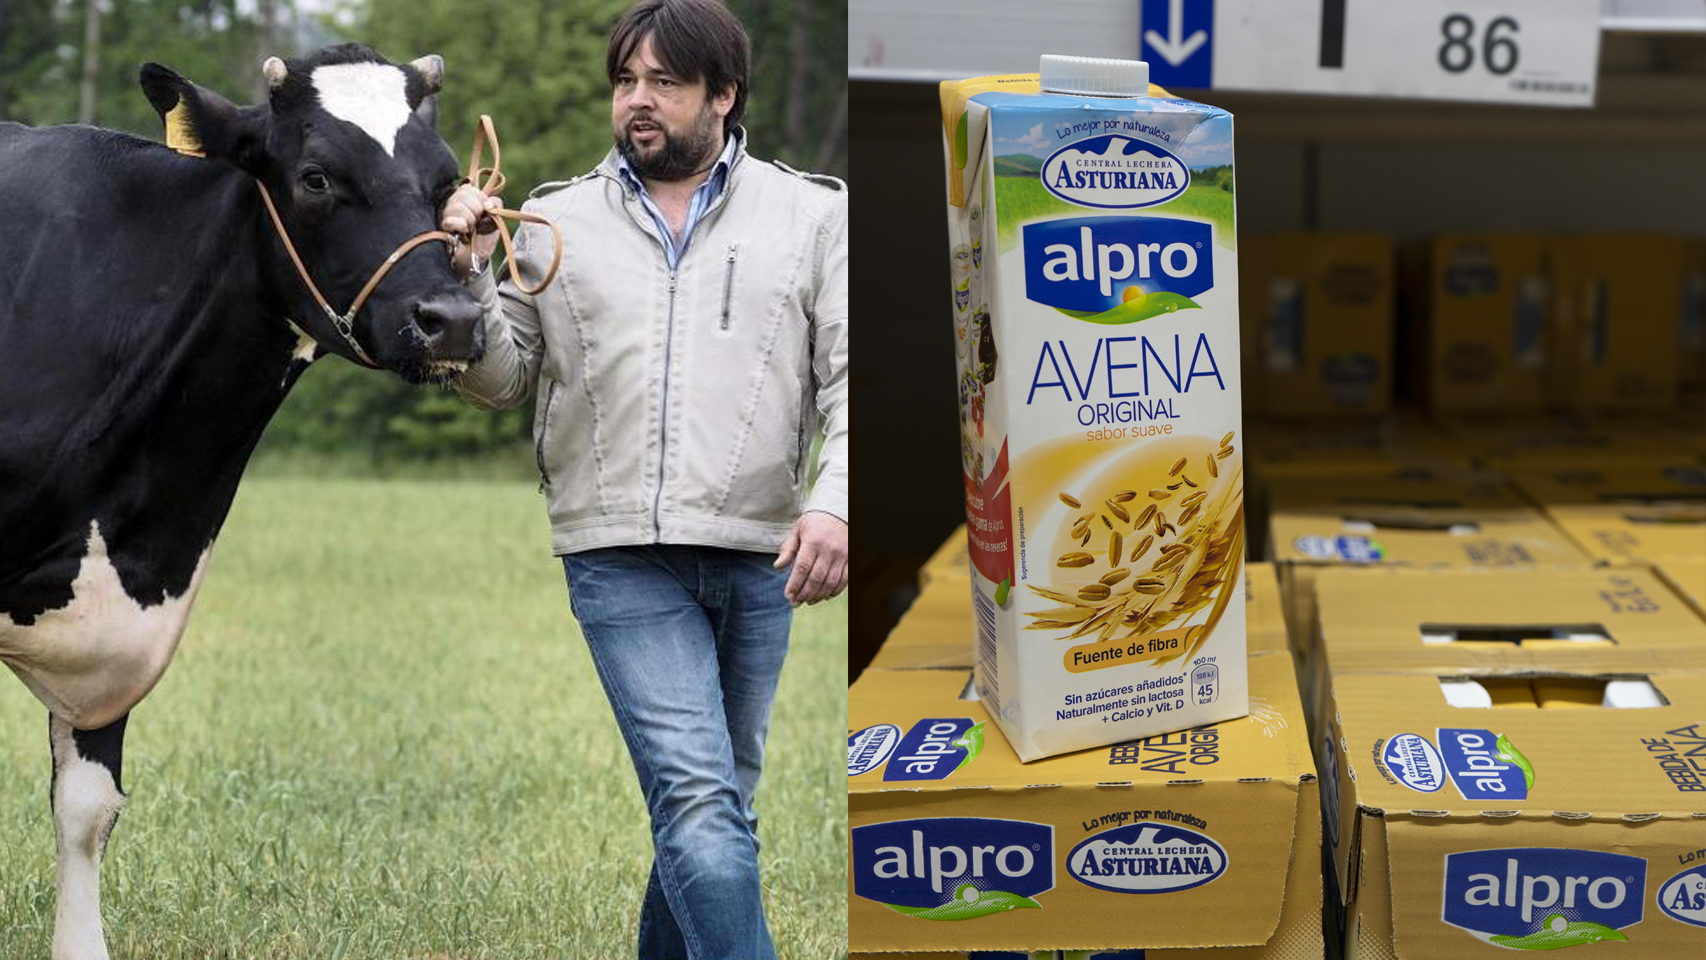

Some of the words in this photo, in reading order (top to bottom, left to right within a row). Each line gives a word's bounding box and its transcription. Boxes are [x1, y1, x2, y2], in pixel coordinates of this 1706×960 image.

[1437, 12, 1521, 76] 86
[1057, 128, 1071, 139] Lo
[1072, 120, 1101, 136] mejor
[1104, 120, 1121, 134] por
[1123, 120, 1171, 142] naturaleza
[1054, 160, 1178, 190] ASTURIANA
[1076, 159, 1122, 167] CENTRAL
[1126, 160, 1172, 168] LECHERA
[1042, 226, 1198, 296] alpro
[1026, 333, 1225, 404] AVENA
[1077, 398, 1180, 426] ORIGINAL
[1087, 426, 1127, 442] sabor
[1131, 424, 1173, 437] suave
[1018, 507, 1026, 539] preparación
[1020, 549, 1028, 580] Sugerencia
[1074, 648, 1123, 666] Fuente
[1127, 643, 1144, 656] de
[1148, 637, 1178, 652] fibra
[1193, 656, 1206, 666] 100
[1056, 698, 1129, 721] Naturalmente
[1131, 694, 1146, 705] sin
[1148, 688, 1184, 702] lactosa
[1065, 694, 1083, 706] Sin
[1085, 685, 1134, 702] azúcares
[1198, 684, 1213, 697] 45
[1199, 696, 1211, 704] kcal
[1111, 707, 1144, 722] Calcio
[1147, 707, 1153, 717] y
[1156, 702, 1173, 713] Vit.
[1175, 699, 1184, 709] D
[898, 722, 957, 774] alpro
[1140, 733, 1187, 774] AVE
[1640, 738, 1676, 752] DE
[1406, 738, 1437, 787] ASTURIANA
[1458, 733, 1510, 793] alpro
[1654, 753, 1706, 792] BEBIDA
[1082, 818, 1099, 832] Lo
[1100, 812, 1131, 827] mejor
[1134, 810, 1152, 823] por
[1154, 810, 1207, 830] naturaleza
[873, 830, 1034, 893] alpro
[1079, 849, 1214, 876] ASTURIANA
[1158, 847, 1209, 855] LECHERA
[1678, 852, 1695, 865] Lo
[1464, 858, 1627, 923] alpro
